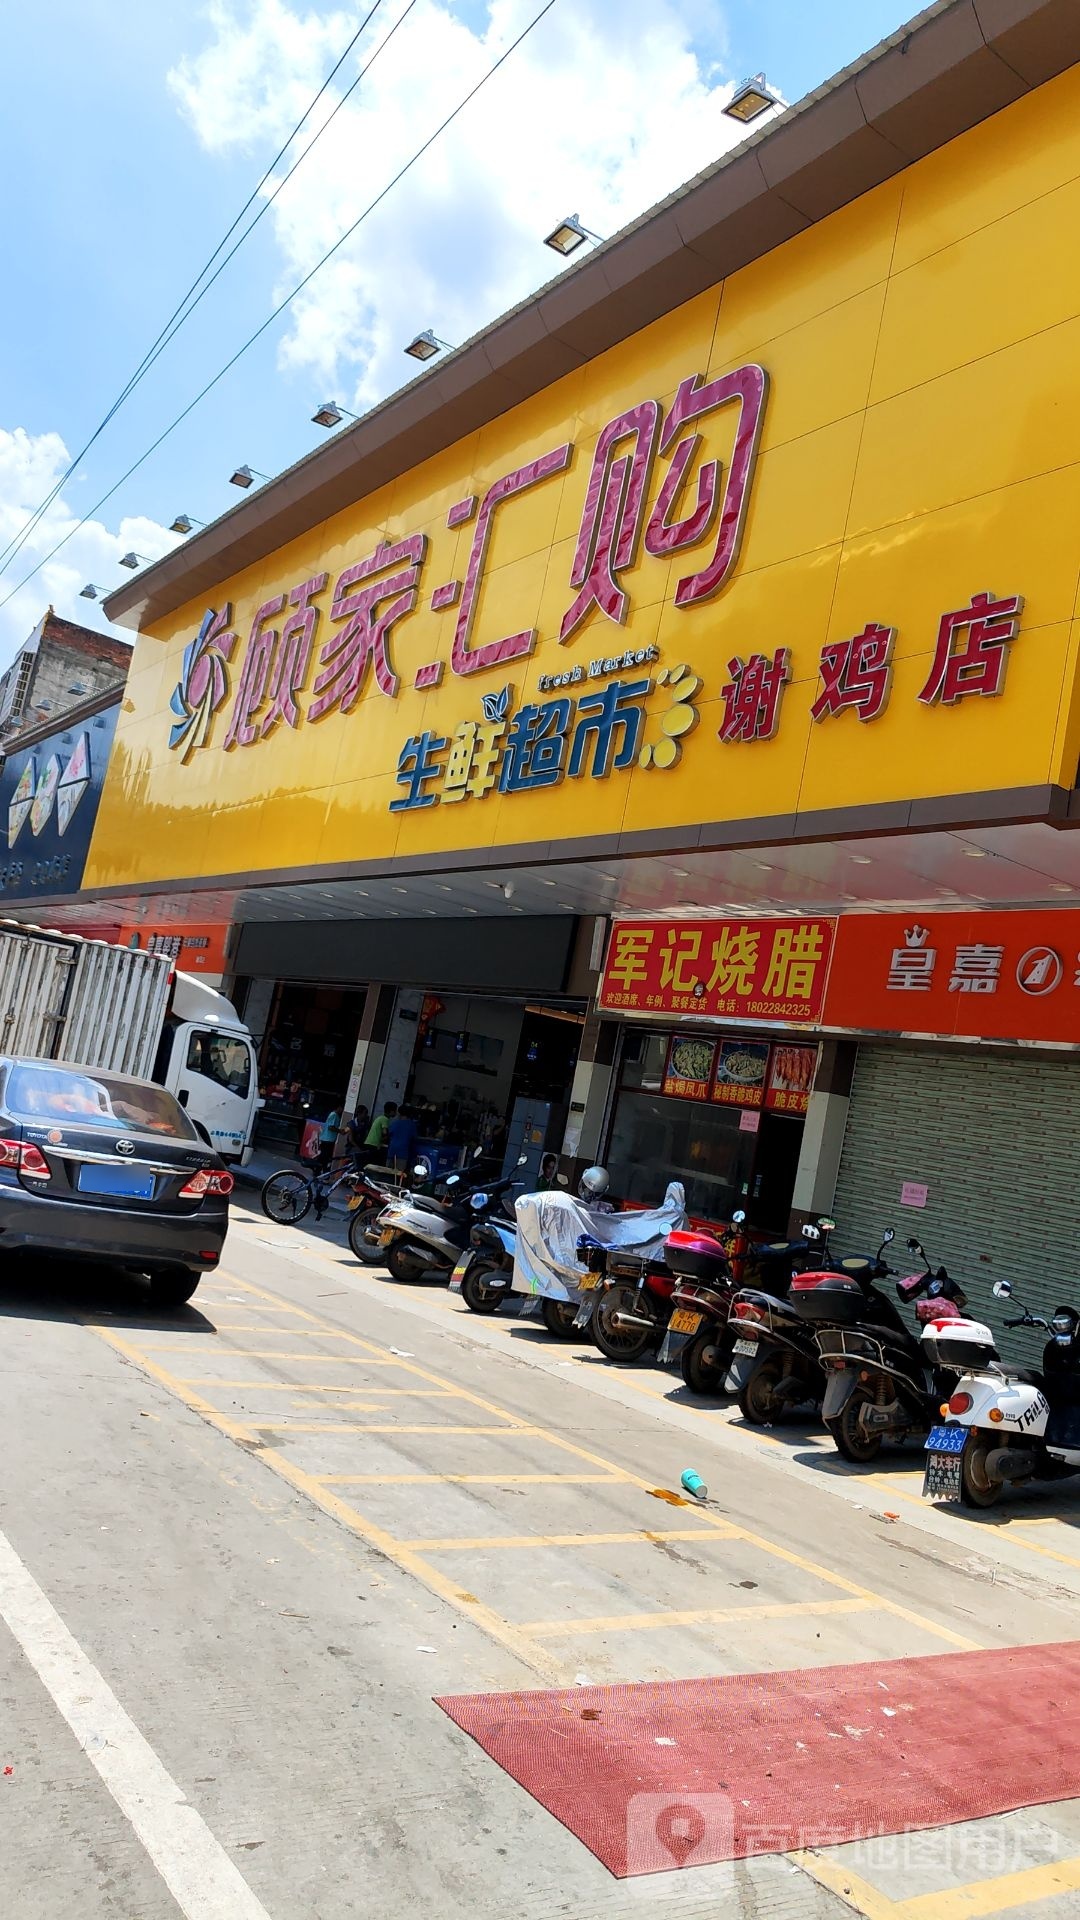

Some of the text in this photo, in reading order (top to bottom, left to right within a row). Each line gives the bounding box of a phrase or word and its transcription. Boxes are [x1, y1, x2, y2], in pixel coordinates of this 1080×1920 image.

[223, 363, 770, 752] 顾家汇购
[588, 644, 659, 678] Market
[718, 592, 1025, 743] 谢鸡店
[388, 677, 654, 812] 生鲜超市
[608, 924, 824, 999] 军记烧腊
[927, 1437, 962, 1451] 94933
